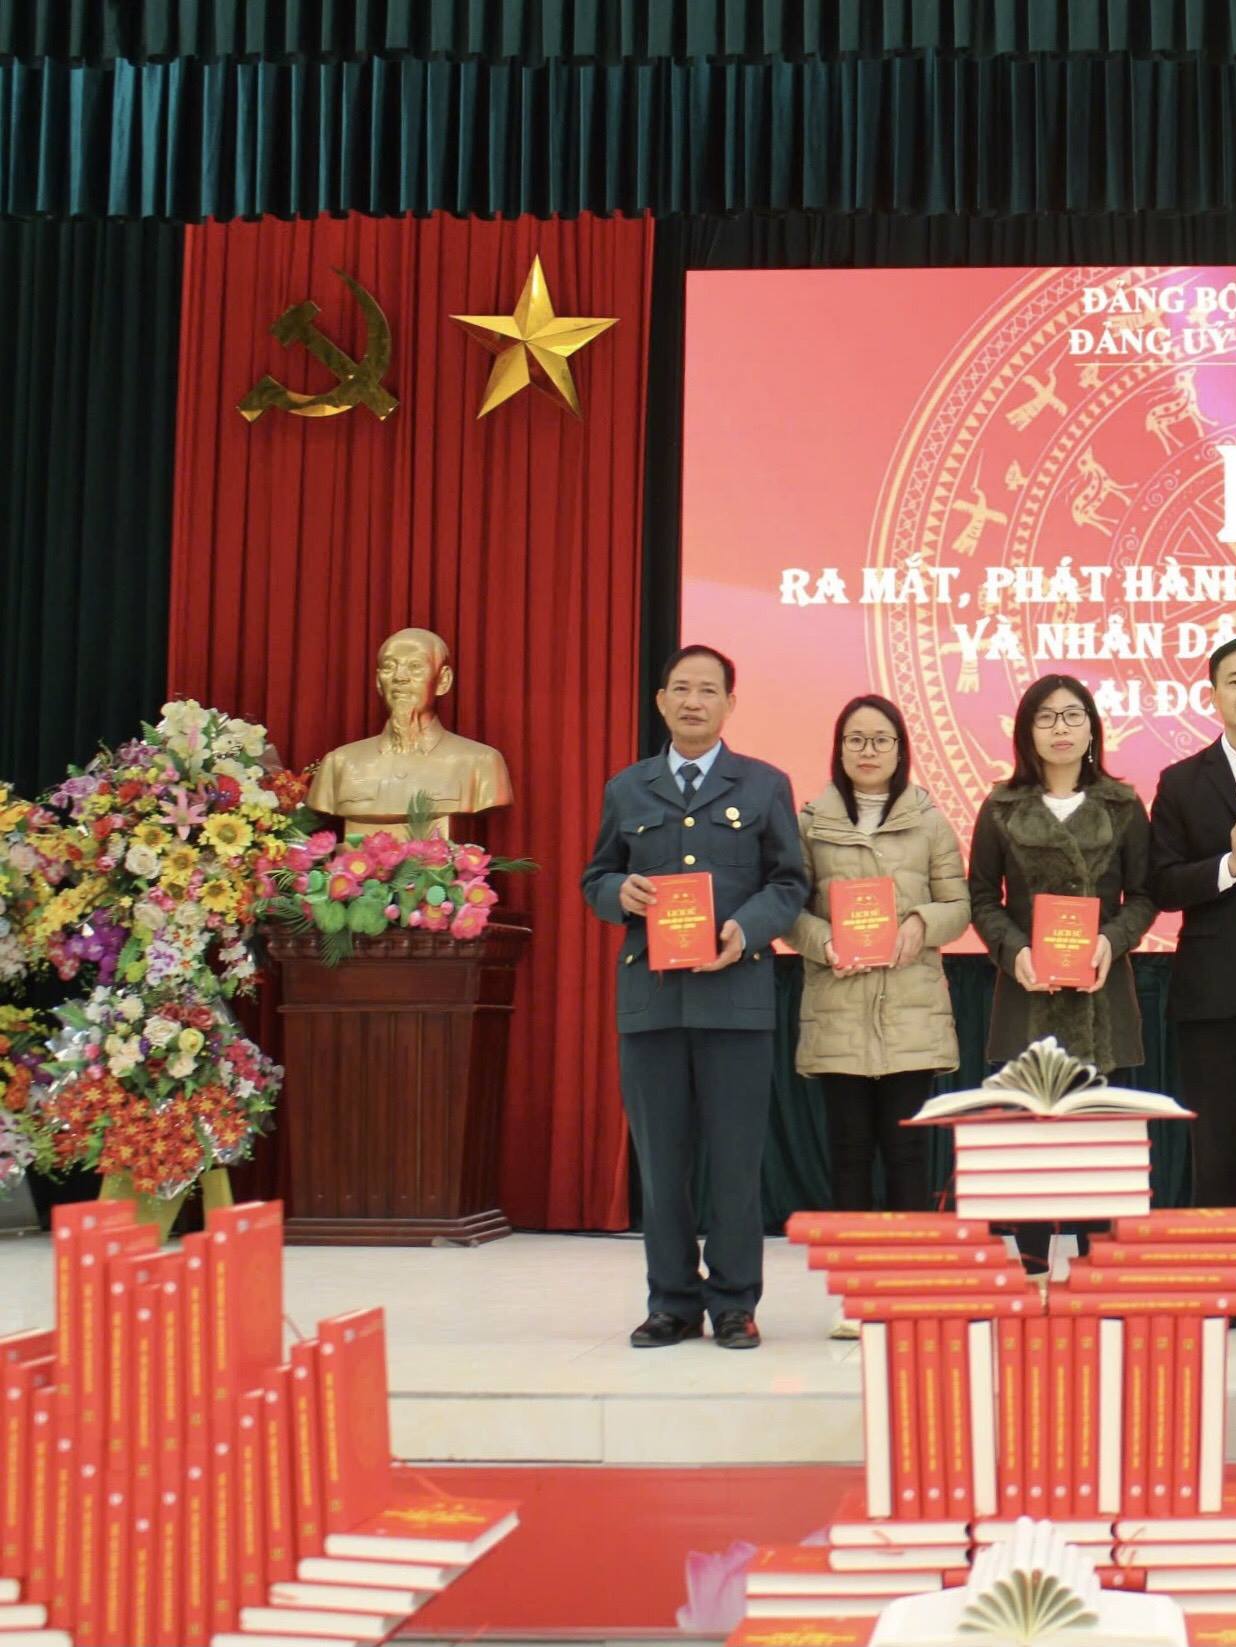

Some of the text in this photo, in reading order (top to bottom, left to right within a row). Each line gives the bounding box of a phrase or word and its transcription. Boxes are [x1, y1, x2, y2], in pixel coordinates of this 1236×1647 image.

[1081, 280, 1185, 313] ĐẢNG
[1068, 320, 1171, 355] ĐẢNG
[779, 567, 850, 607] RA
[859, 552, 971, 608] MẮT,
[984, 555, 1113, 603] PHÁT
[953, 613, 1025, 660] VÀ
[1034, 614, 1165, 660] NHÂN
